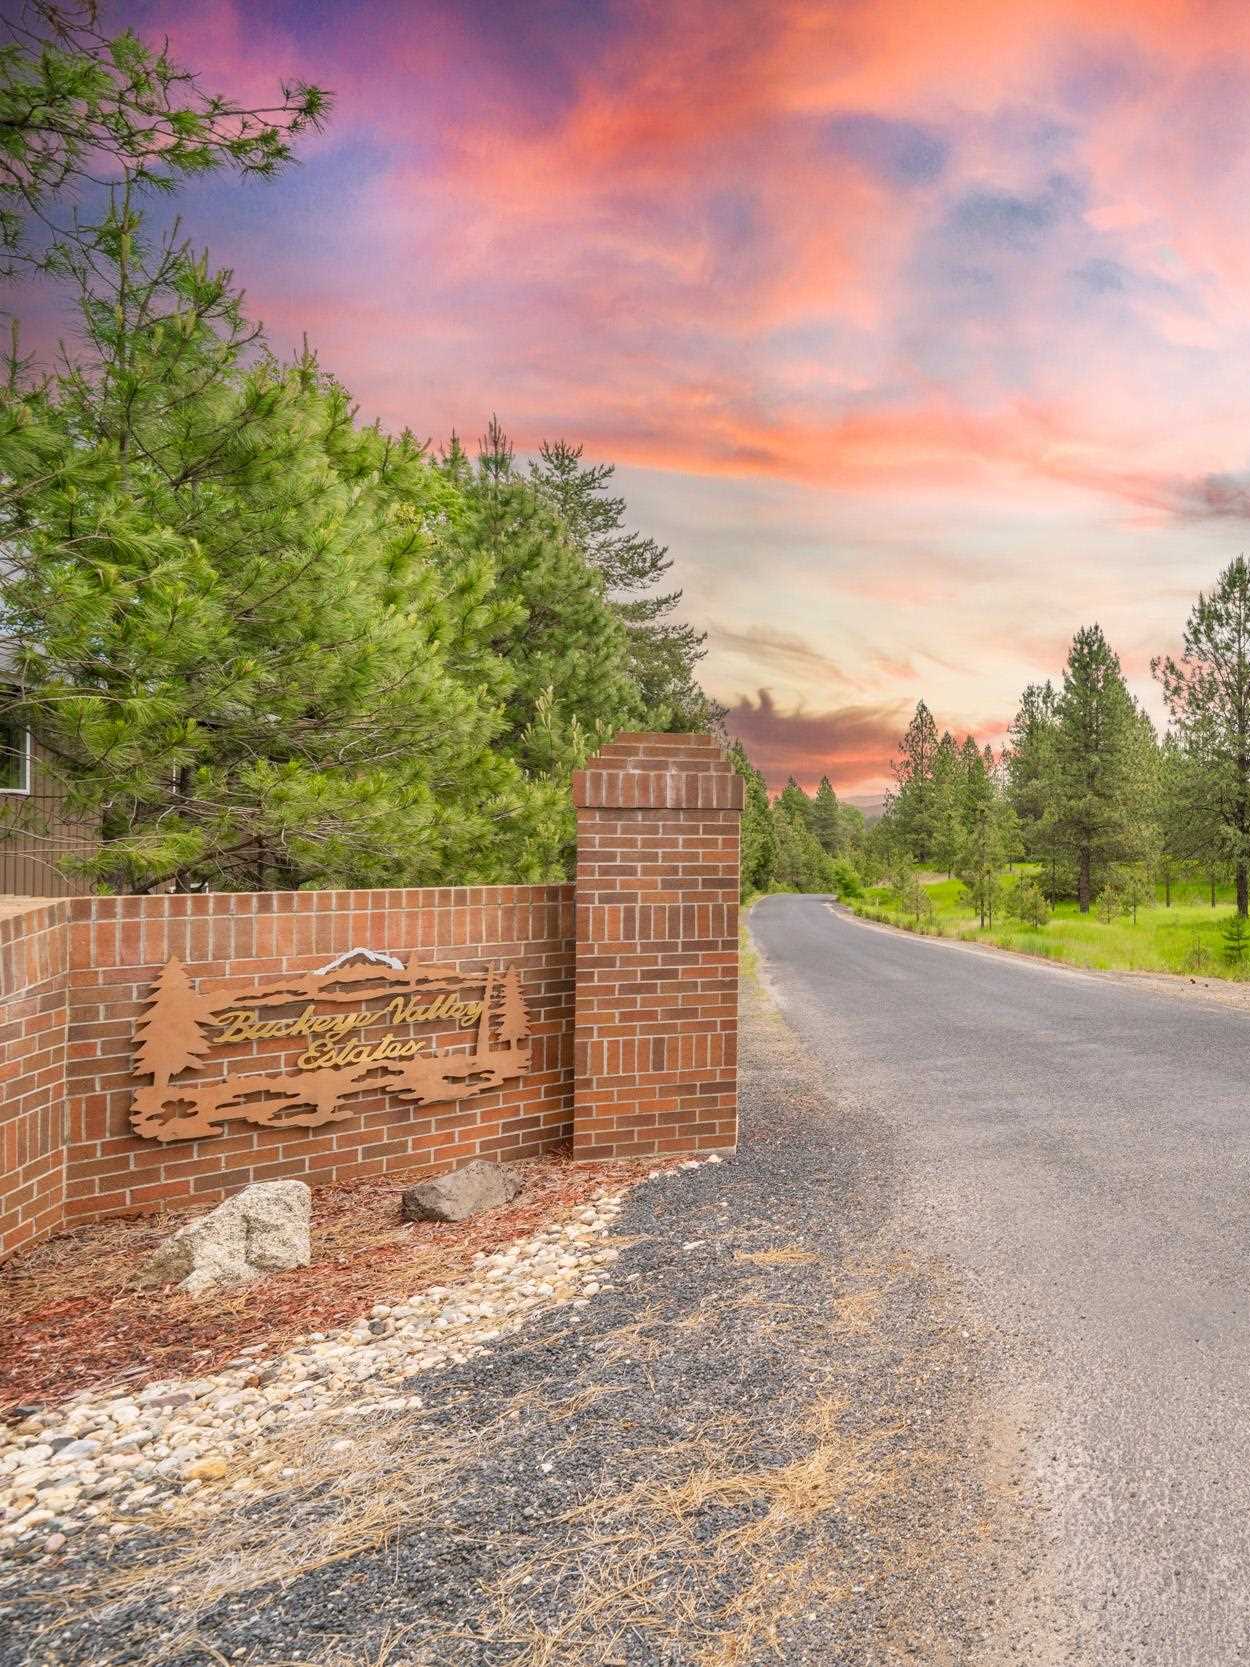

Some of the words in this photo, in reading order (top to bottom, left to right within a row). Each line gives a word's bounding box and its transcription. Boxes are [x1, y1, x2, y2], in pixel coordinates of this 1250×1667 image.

[213, 1004, 384, 1043] Buckeye
[387, 993, 483, 1027] Valley
[298, 1033, 426, 1070] Estates
